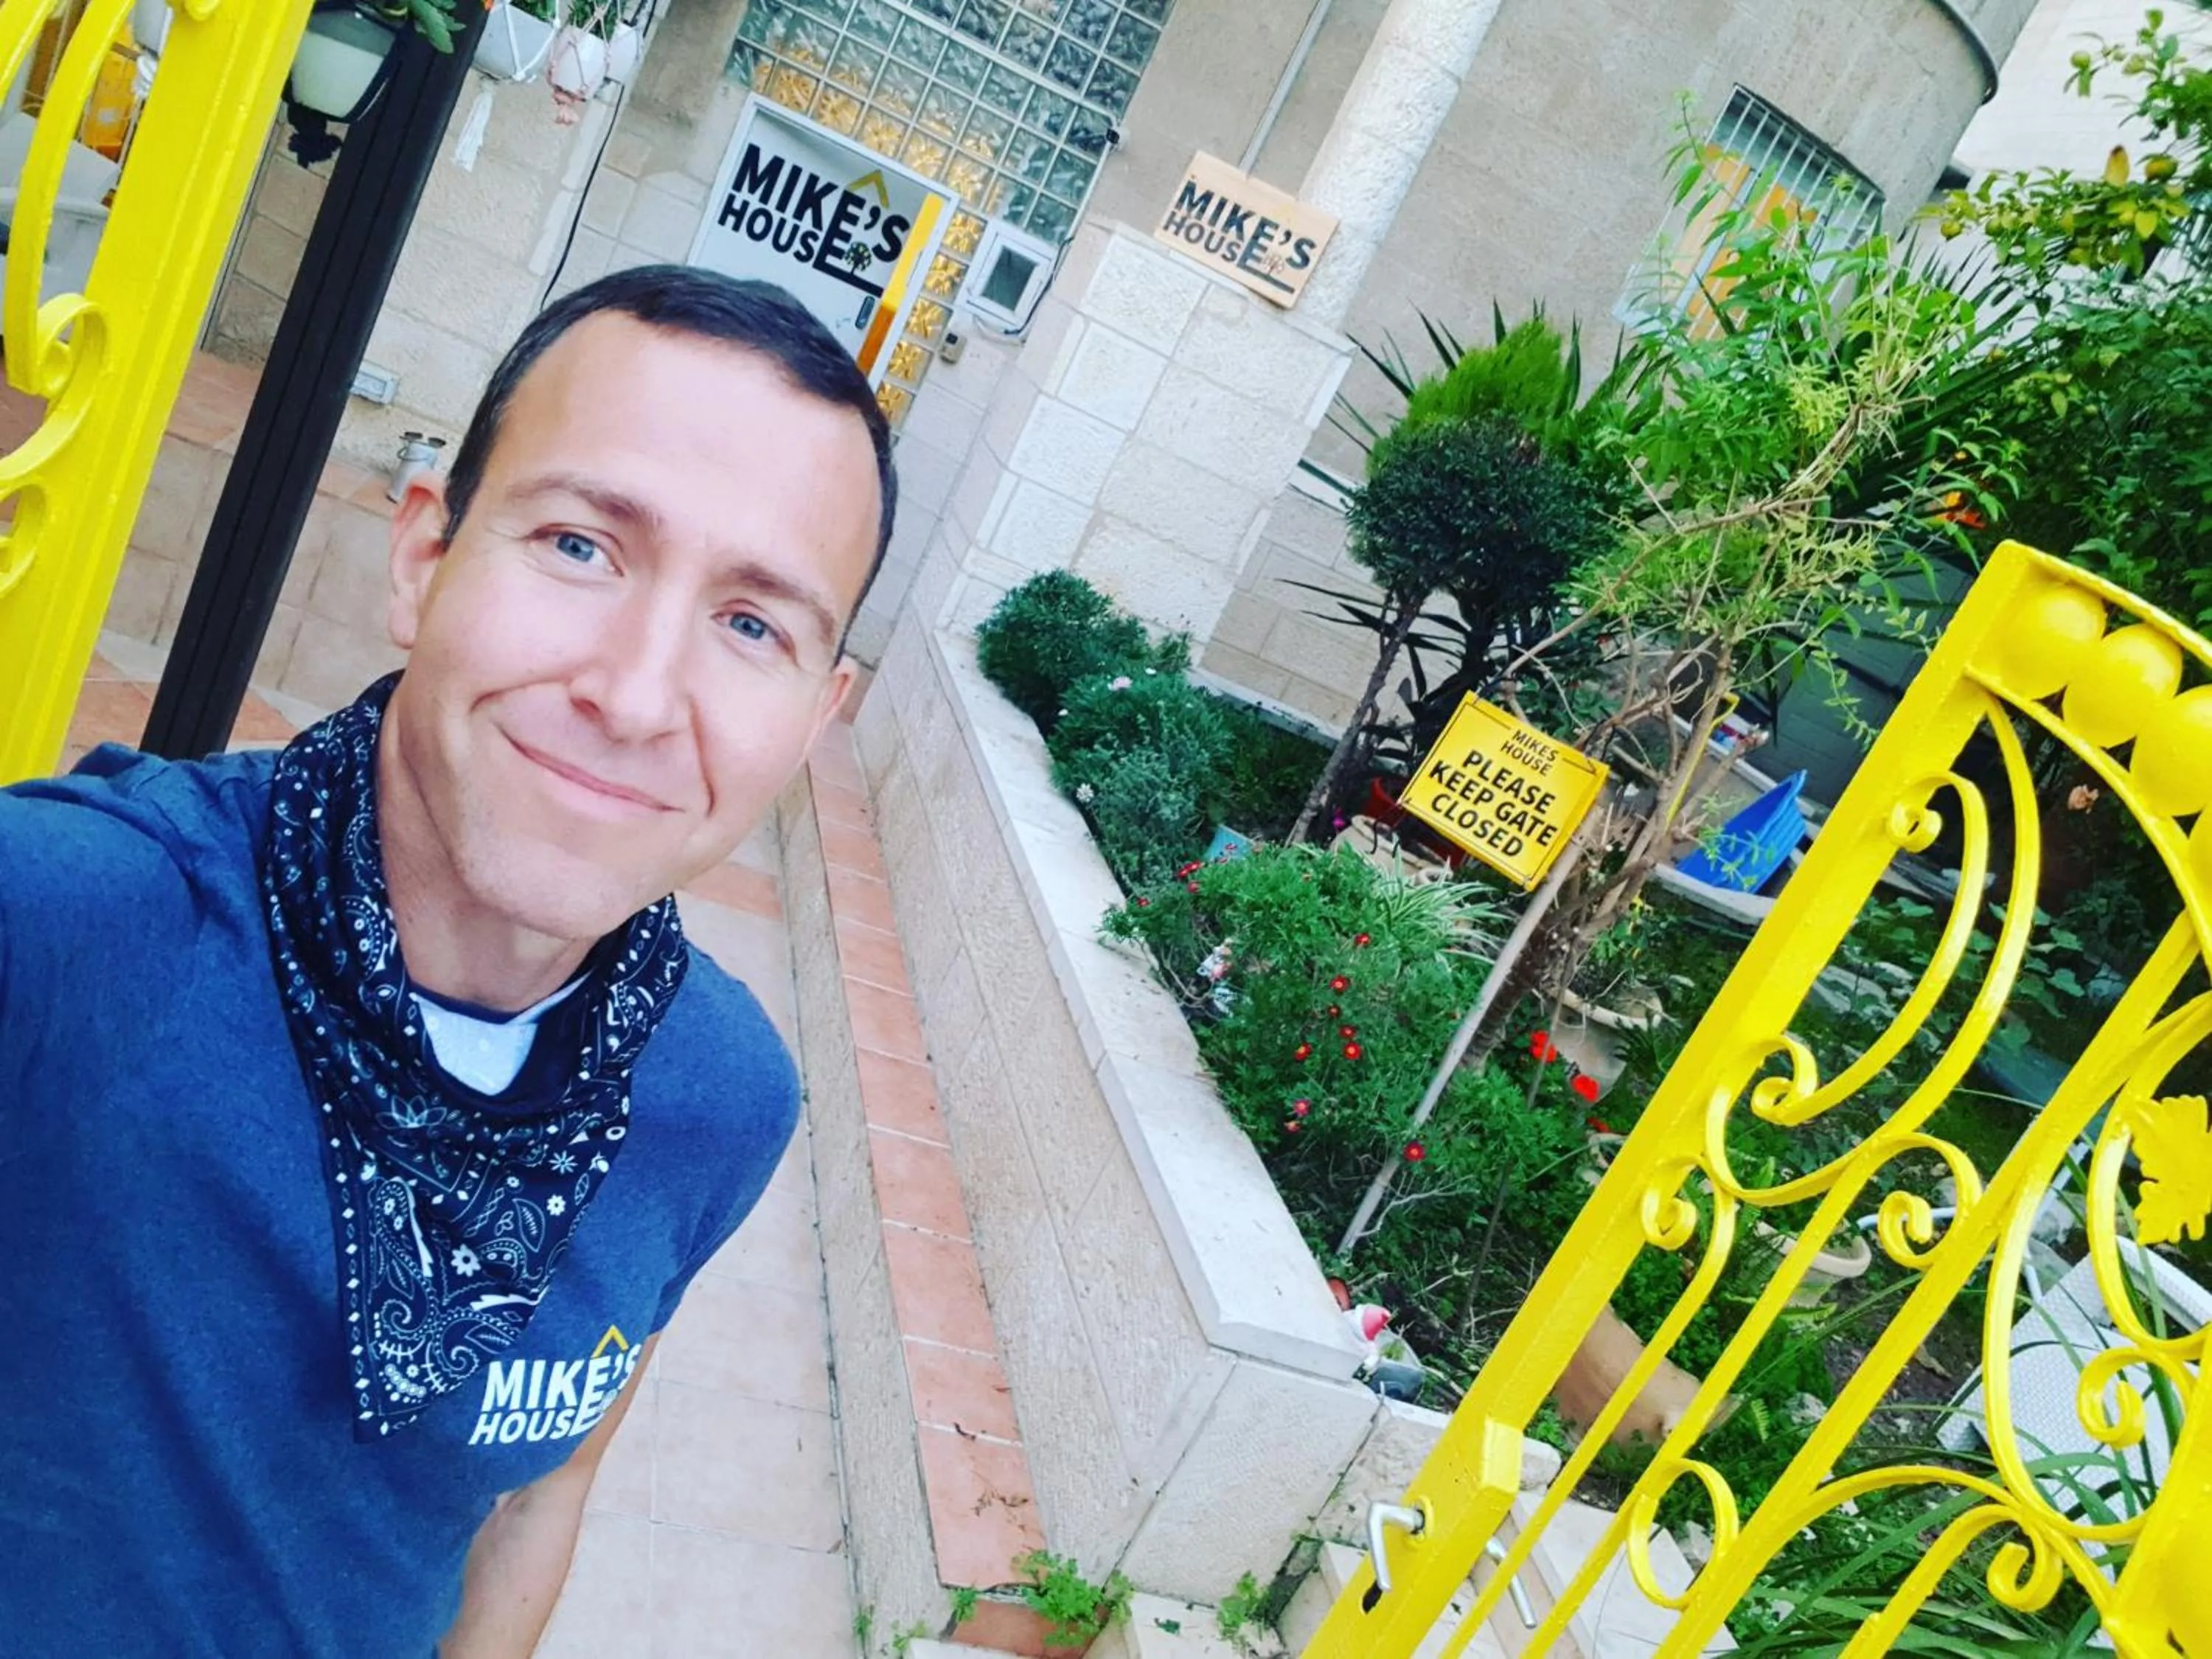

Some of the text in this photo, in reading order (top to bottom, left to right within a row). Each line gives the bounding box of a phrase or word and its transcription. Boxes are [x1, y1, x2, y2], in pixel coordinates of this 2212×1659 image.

[732, 143, 911, 262] MIKE'S
[1175, 180, 1317, 270] MIKE'S
[718, 193, 884, 299] HOUSE
[1163, 211, 1295, 294] HOUSE
[1462, 749, 1556, 814] PLEASE
[1500, 740, 1554, 776] HOUSE
[1512, 729, 1560, 762] MIKES
[1428, 760, 1558, 847] KEEP GATE
[1431, 793, 1524, 858] CLOSED
[467, 1392, 606, 1445] HOUSE
